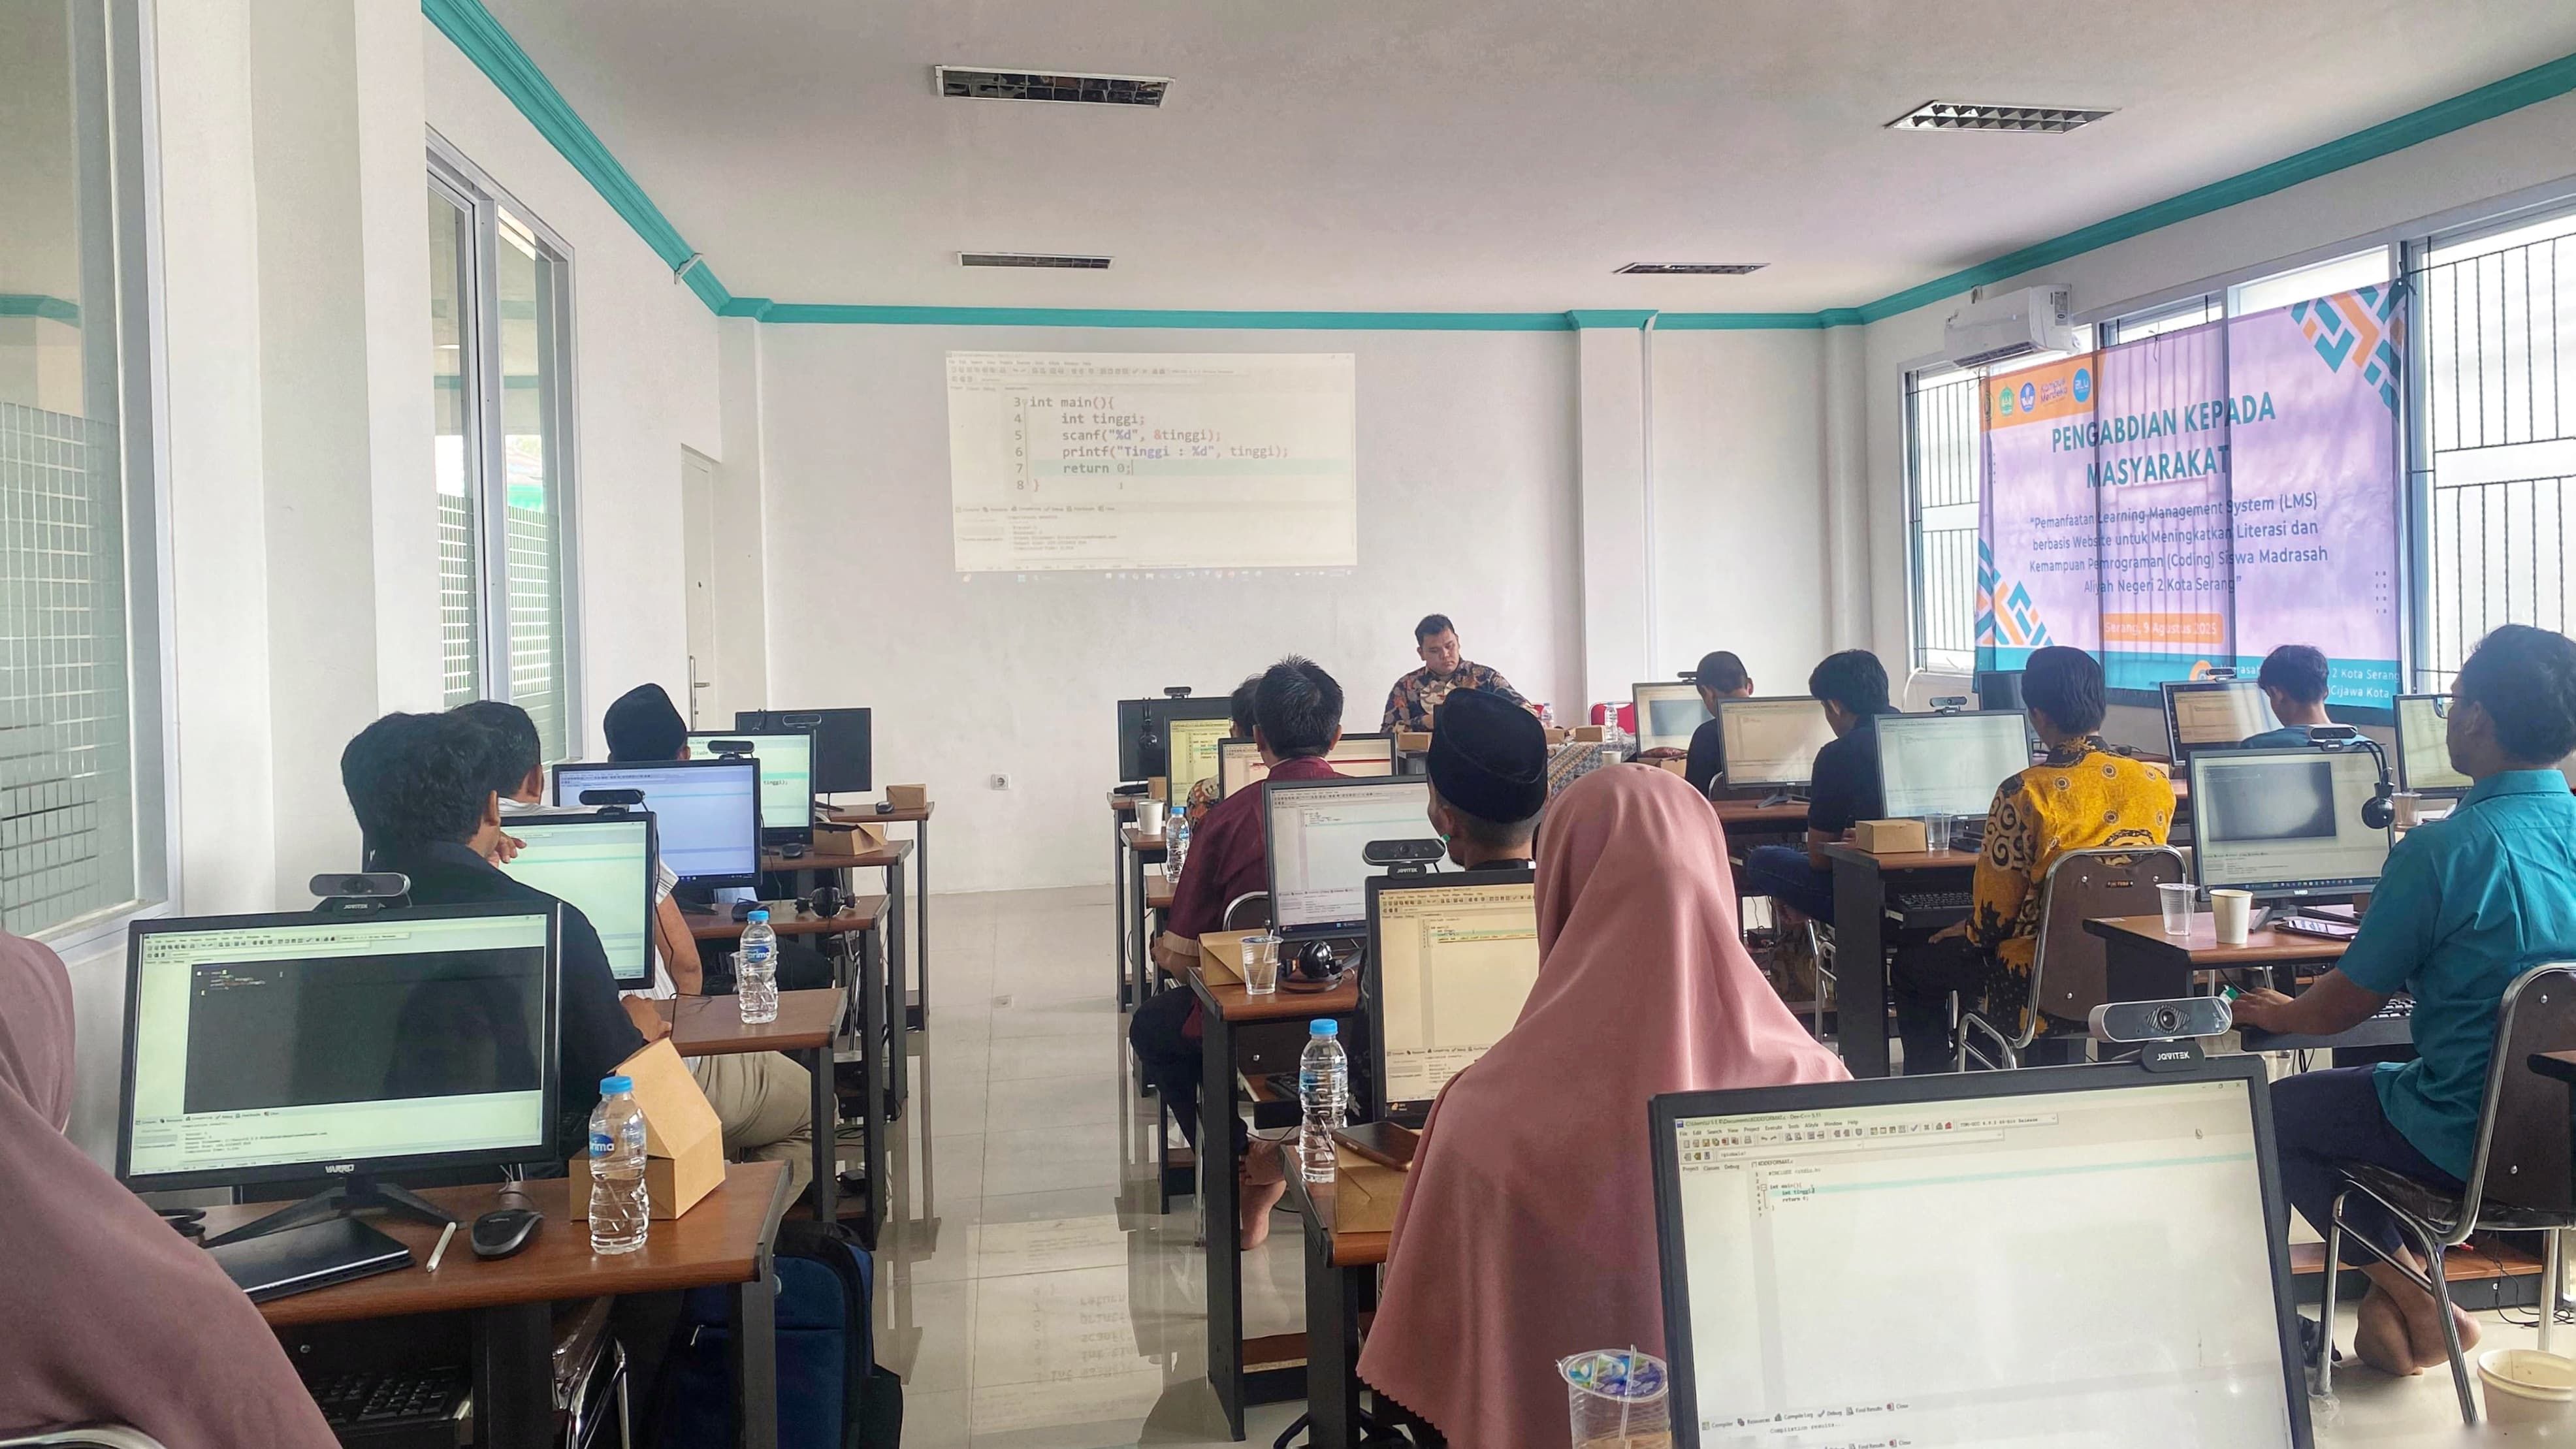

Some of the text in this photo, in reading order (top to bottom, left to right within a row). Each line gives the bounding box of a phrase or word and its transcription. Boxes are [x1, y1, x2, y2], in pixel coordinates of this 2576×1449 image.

[1014, 396, 1114, 410] 3 int main(){
[1014, 413, 1145, 426] 4 int tinggi;
[2052, 392, 2276, 453] PENGABDIAN KEPADA
[1015, 429, 1221, 443] 5 scanf("%d", &tinggi);
[1016, 447, 1023, 456] 6
[1063, 445, 1170, 459] printf("Tinggi
[1231, 445, 1289, 458] tinggi);
[1016, 464, 1023, 473] 7
[1064, 464, 1109, 473] return
[2087, 445, 2229, 488] MASYARAKAT
[1017, 479, 1040, 492] 8 }
[2097, 507, 2145, 524] Learning
[2149, 502, 2223, 520] Management
[2226, 498, 2274, 516] System
[2279, 491, 2317, 512] (LMS)
[2033, 520, 2318, 550] berbasis Website untuk Meningkatkan Literasi dan
[2029, 546, 2328, 574] Kemampuan Pemrograman (Coding) Siswa Madrasah
[2084, 580, 2114, 596] Aliyah
[2118, 579, 2153, 594] Negeri
[2157, 579, 2164, 591] 2
[2167, 579, 2192, 591] Kota
[2104, 622, 2216, 636] Serang, 9 Agustus 2025
[2332, 667, 2338, 678] 2
[2341, 669, 2363, 679] Kota
[2366, 669, 2400, 683] Serang
[2330, 685, 2389, 698] Cijawa Kota
[589, 1142, 615, 1153] rima
